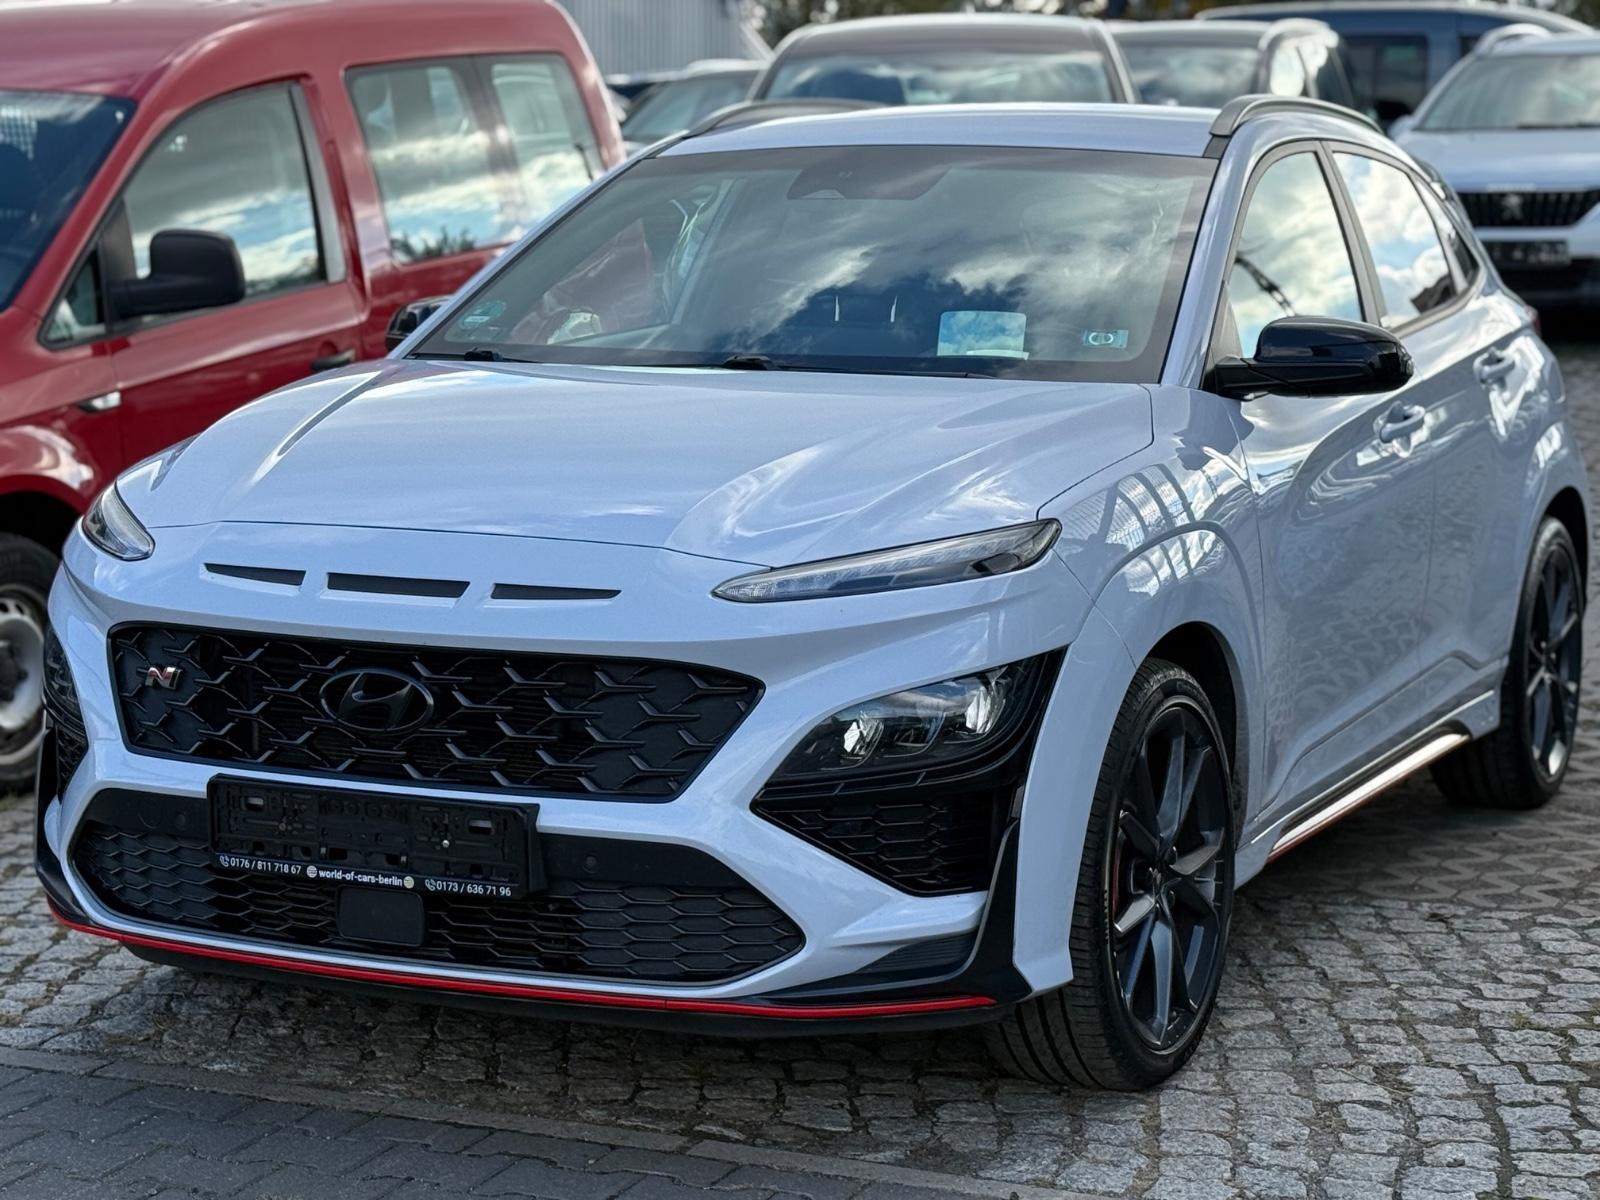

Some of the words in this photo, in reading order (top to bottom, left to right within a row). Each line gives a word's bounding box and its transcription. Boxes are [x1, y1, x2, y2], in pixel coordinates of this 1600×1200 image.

[230, 857, 250, 868] 0176
[257, 860, 271, 872] 811
[274, 862, 290, 873] 718
[291, 864, 302, 874] 67
[318, 867, 403, 886] world-of-cars-berlin
[436, 880, 458, 891] 0173
[467, 883, 484, 894] 636
[486, 885, 496, 895] 71
[499, 886, 512, 897] 96
